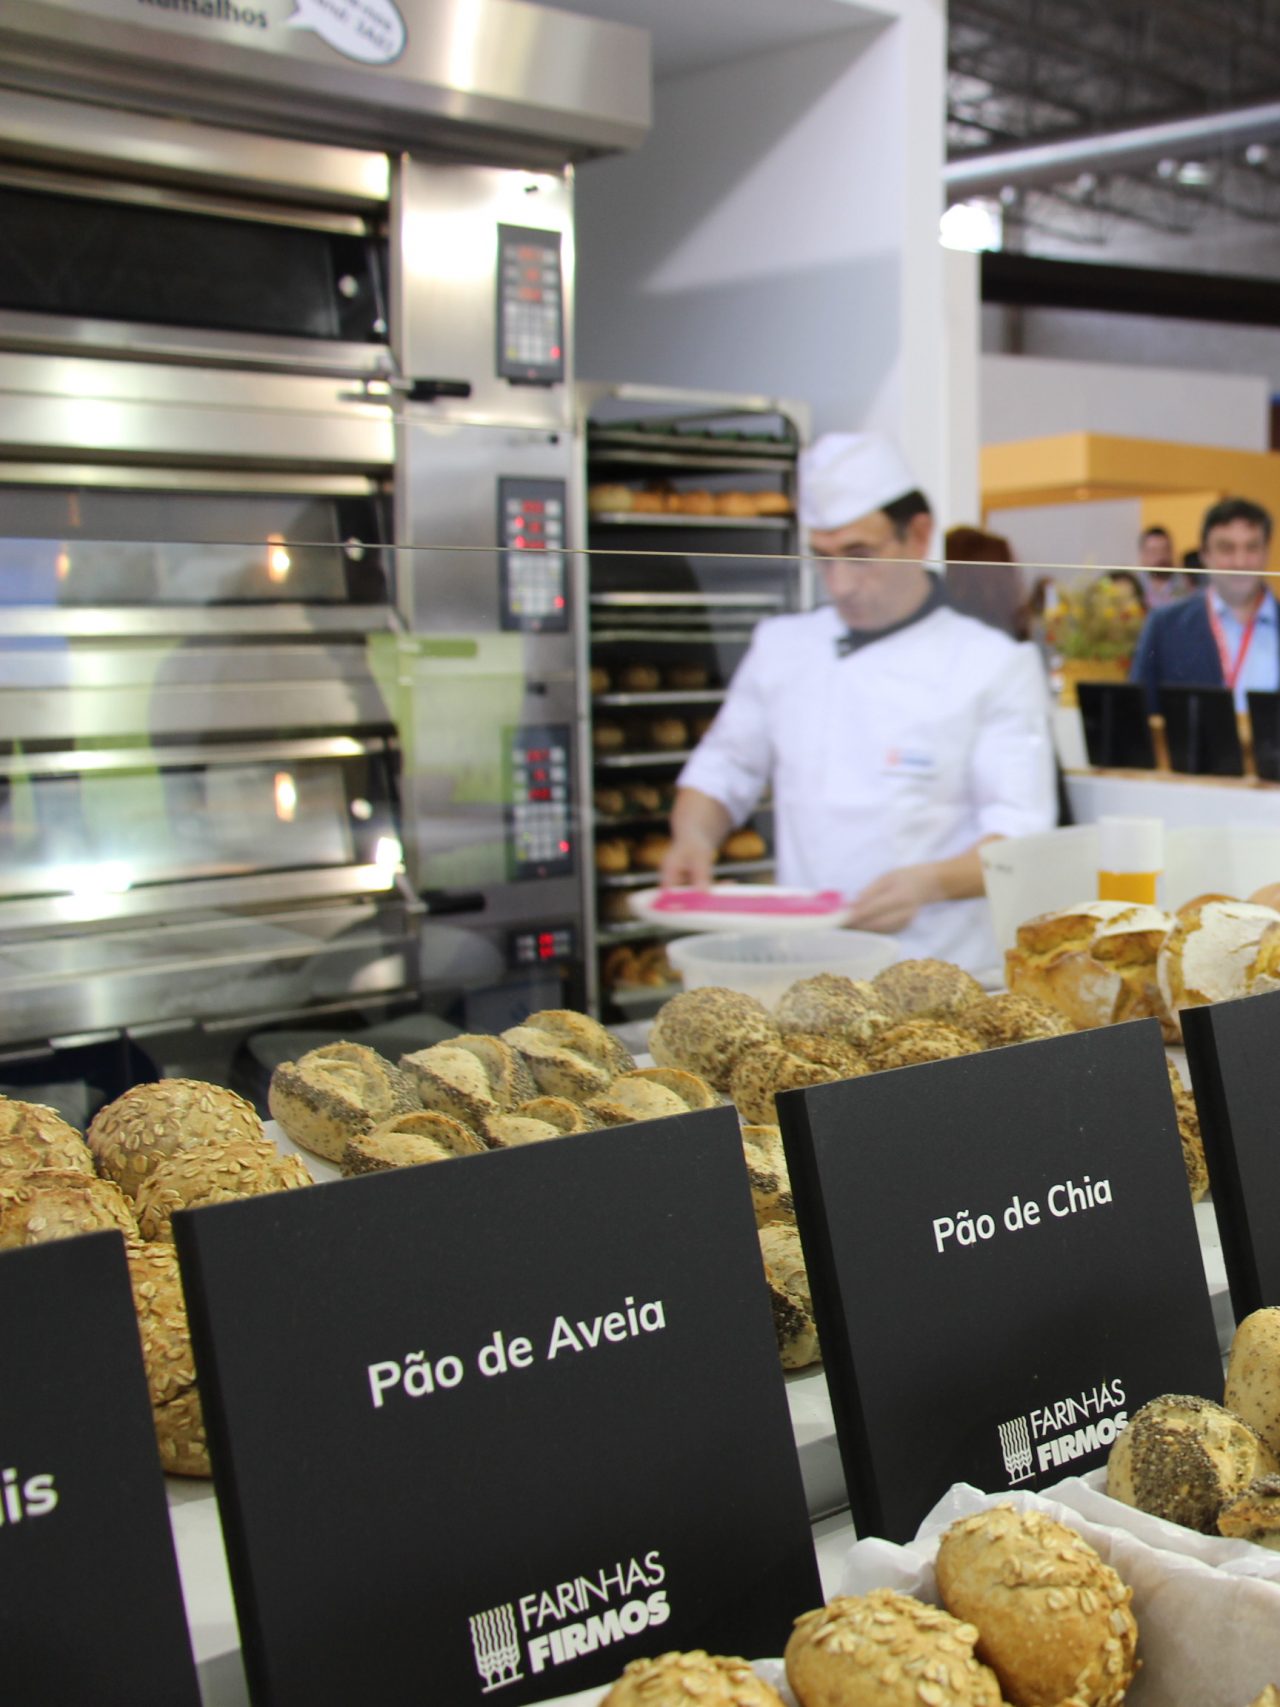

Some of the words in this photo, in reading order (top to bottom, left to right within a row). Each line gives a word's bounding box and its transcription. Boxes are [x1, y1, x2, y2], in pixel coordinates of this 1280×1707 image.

[932, 1209, 996, 1253] Pão
[1003, 1195, 1041, 1232] de
[1047, 1175, 1113, 1218] Chia
[367, 1350, 464, 1408] Pão
[477, 1330, 534, 1377] de
[547, 1296, 667, 1360] Aveia
[1029, 1378, 1126, 1439] FARINHAS
[0, 1466, 58, 1528] is
[519, 1550, 666, 1633] FARINHAS
[527, 1590, 671, 1674] FIRMOS
